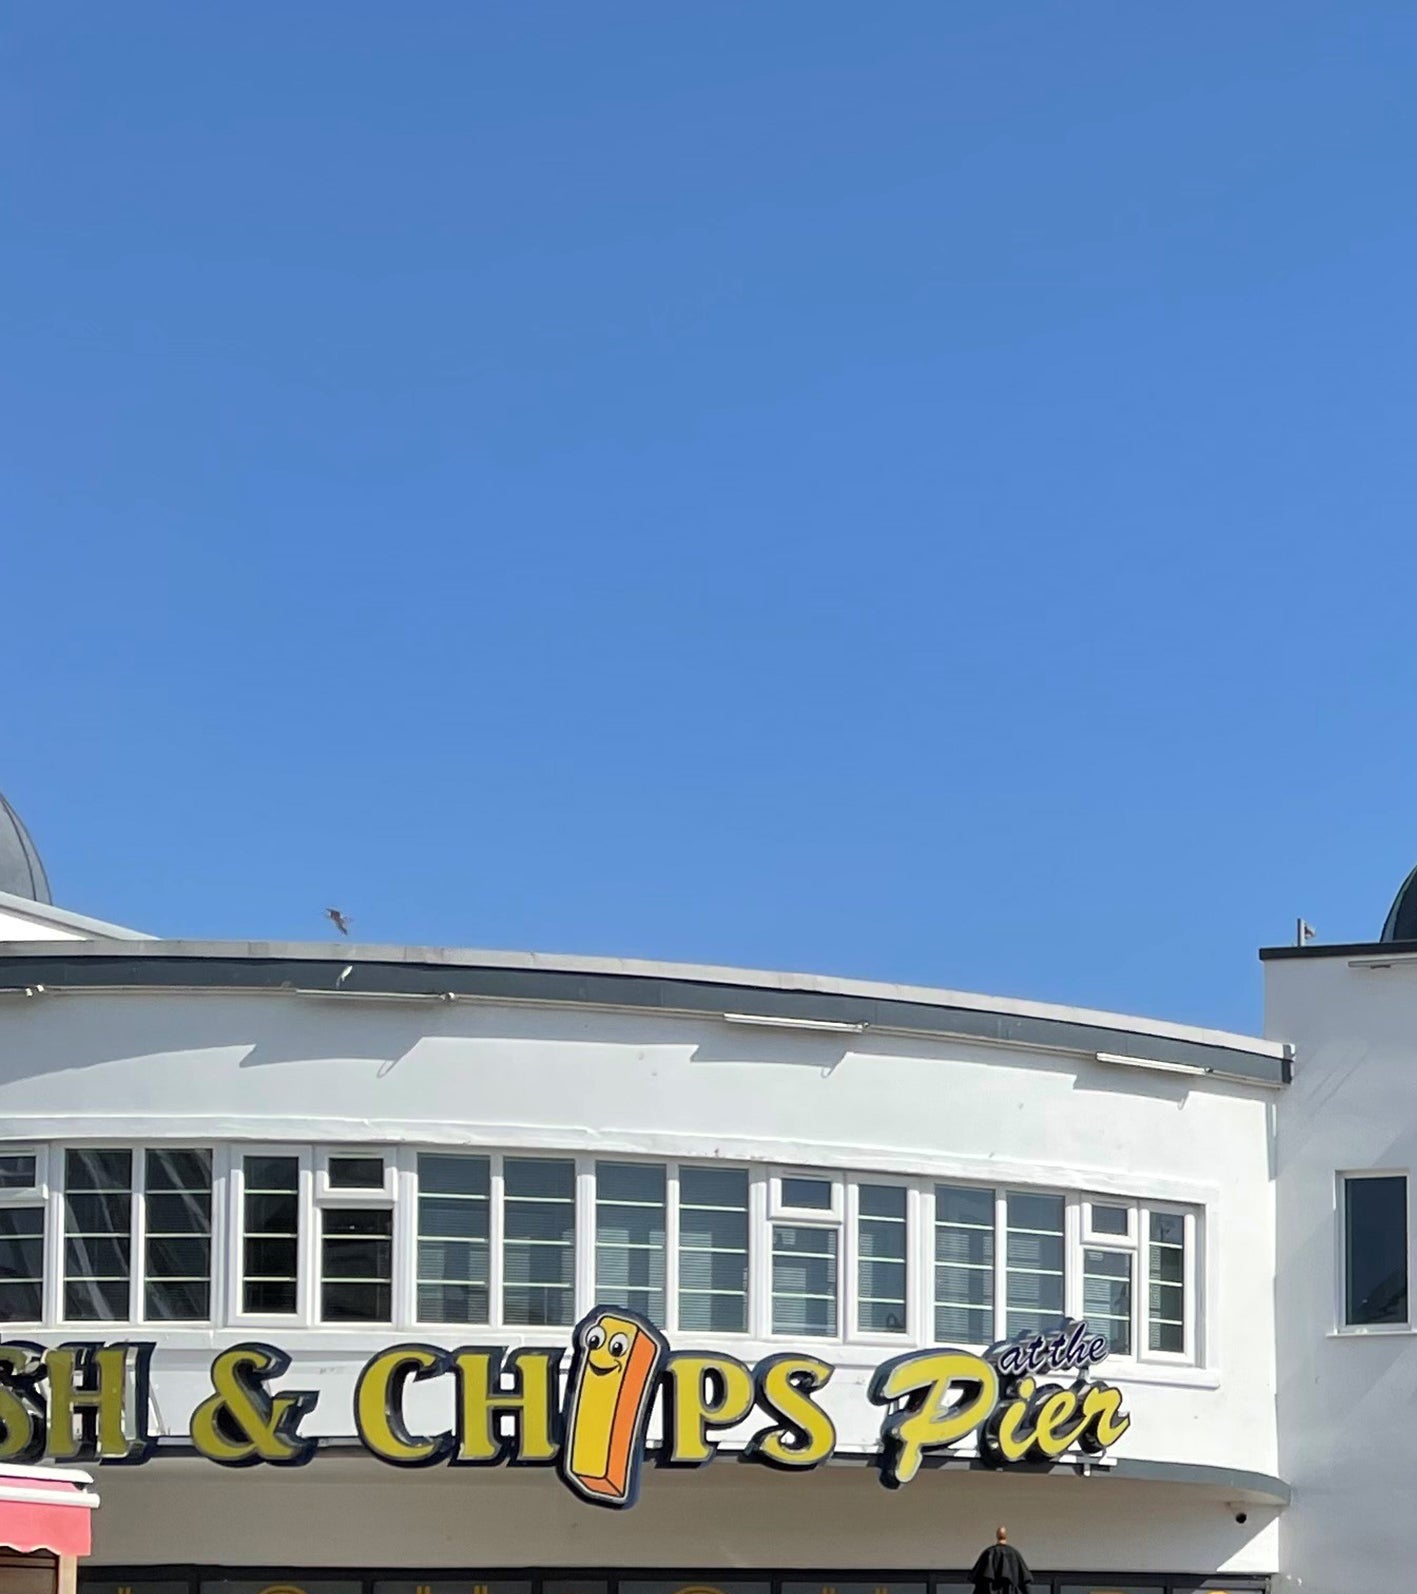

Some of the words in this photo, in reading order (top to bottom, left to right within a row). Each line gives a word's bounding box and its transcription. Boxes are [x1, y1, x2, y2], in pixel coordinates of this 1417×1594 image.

[191, 1342, 312, 1465] &
[999, 1335, 1047, 1374] at
[1047, 1321, 1110, 1370] the
[870, 1348, 1132, 1488] Pier
